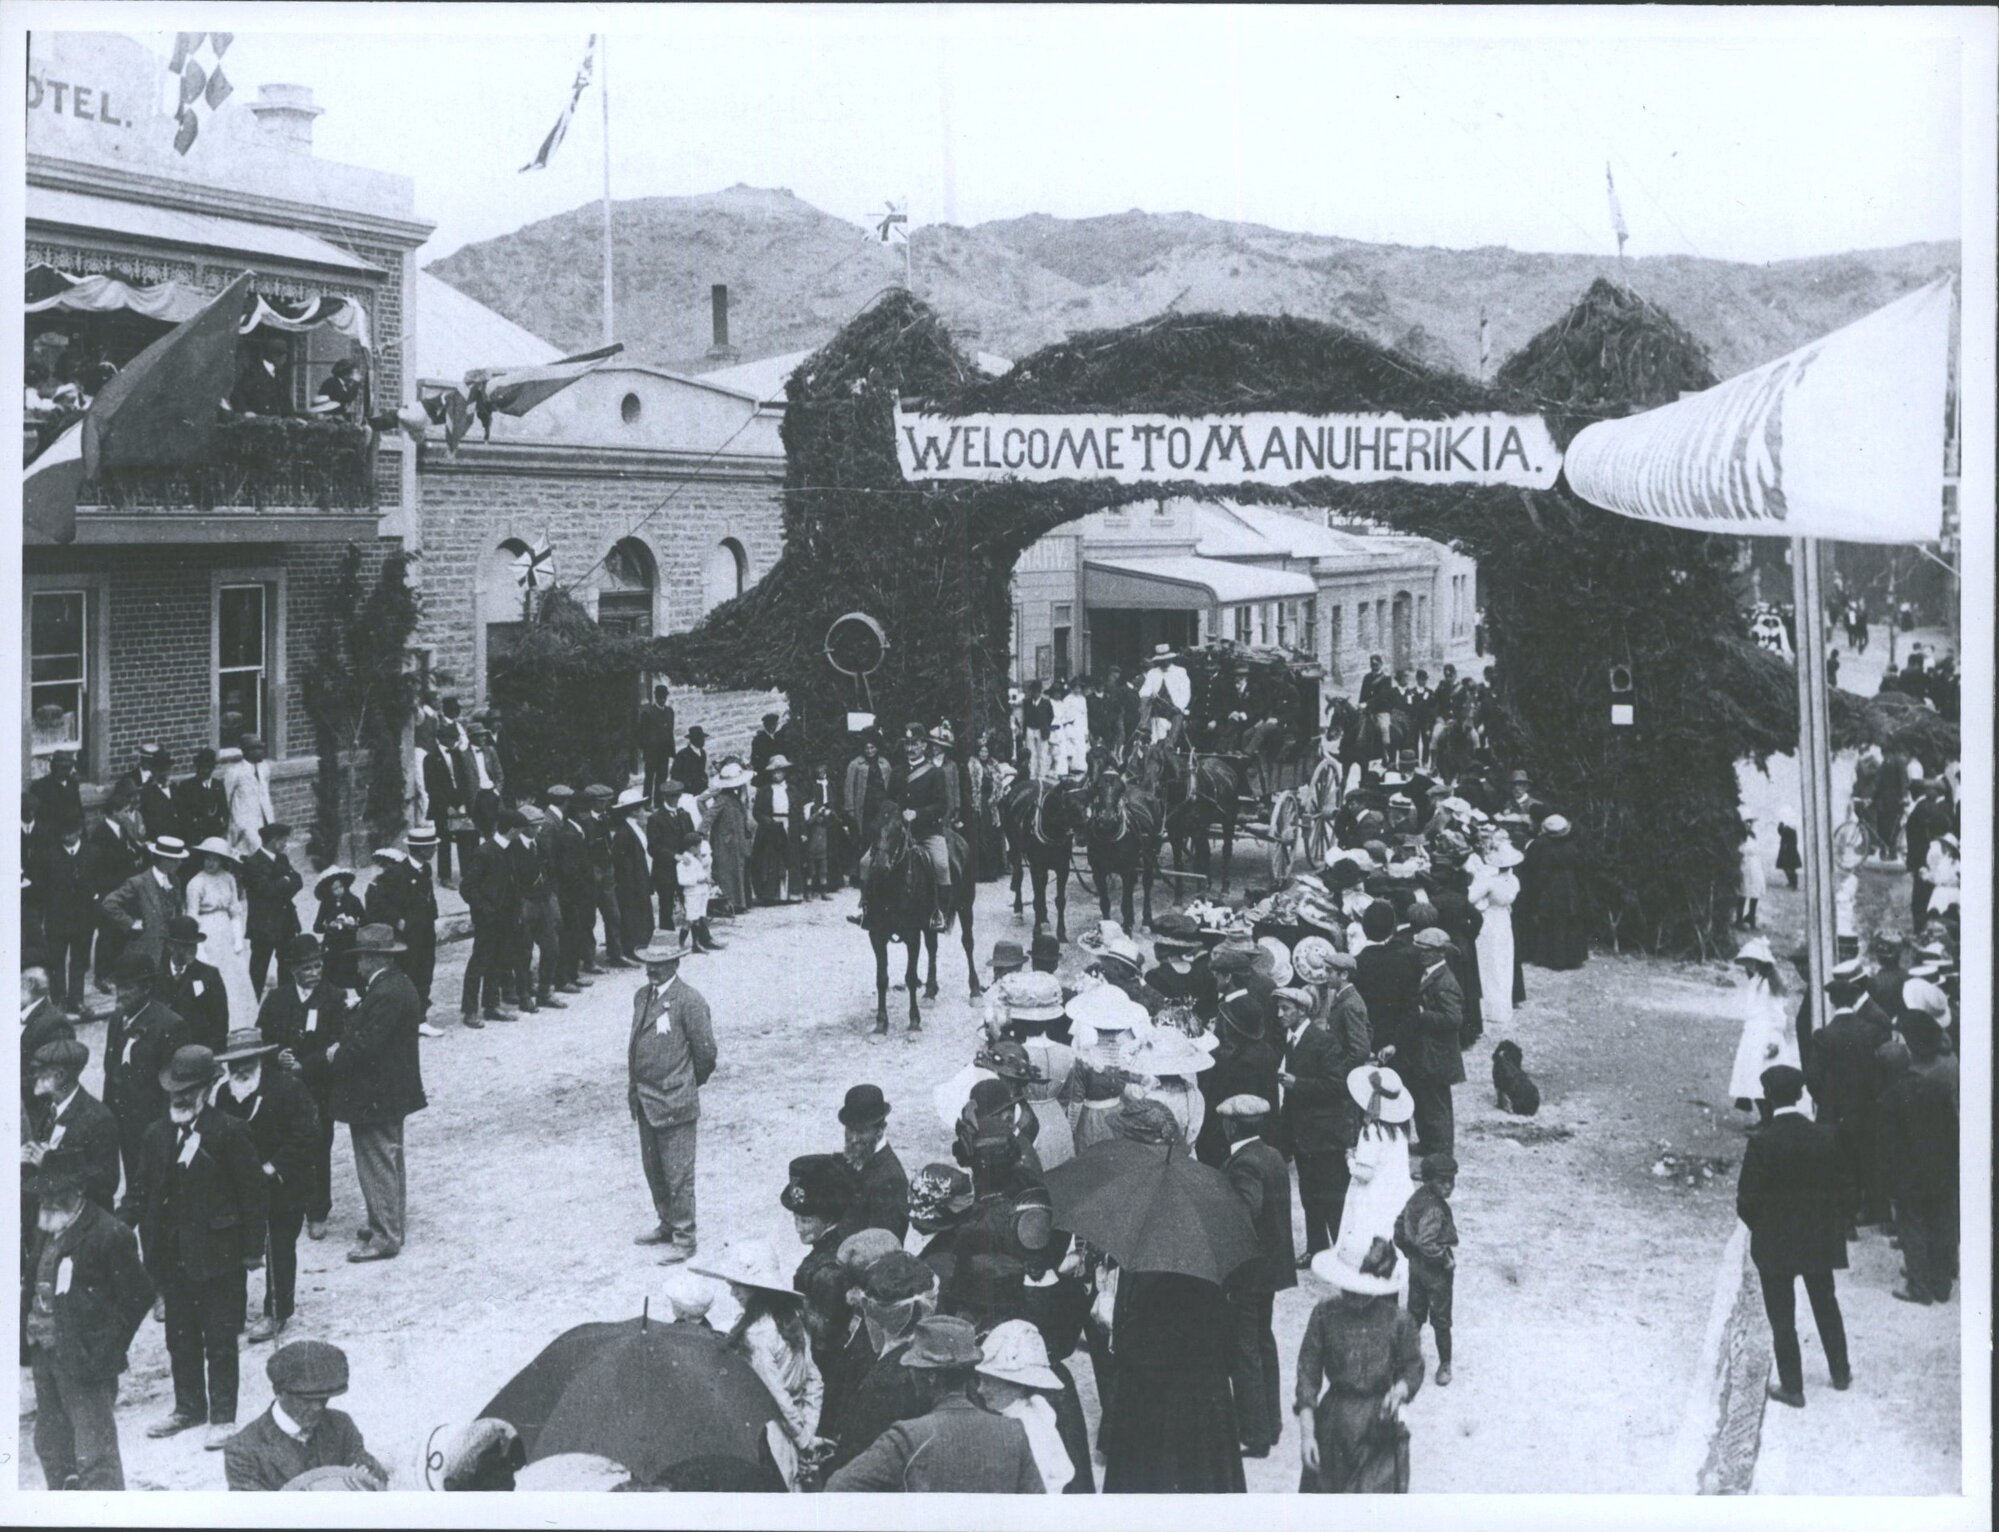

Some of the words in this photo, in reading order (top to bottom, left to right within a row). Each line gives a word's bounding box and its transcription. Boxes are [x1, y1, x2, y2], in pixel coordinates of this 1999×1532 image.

[902, 426, 1124, 470] WELCOME
[1132, 424, 1191, 471] TO
[1195, 425, 1543, 472] MANUHERIKIA.
